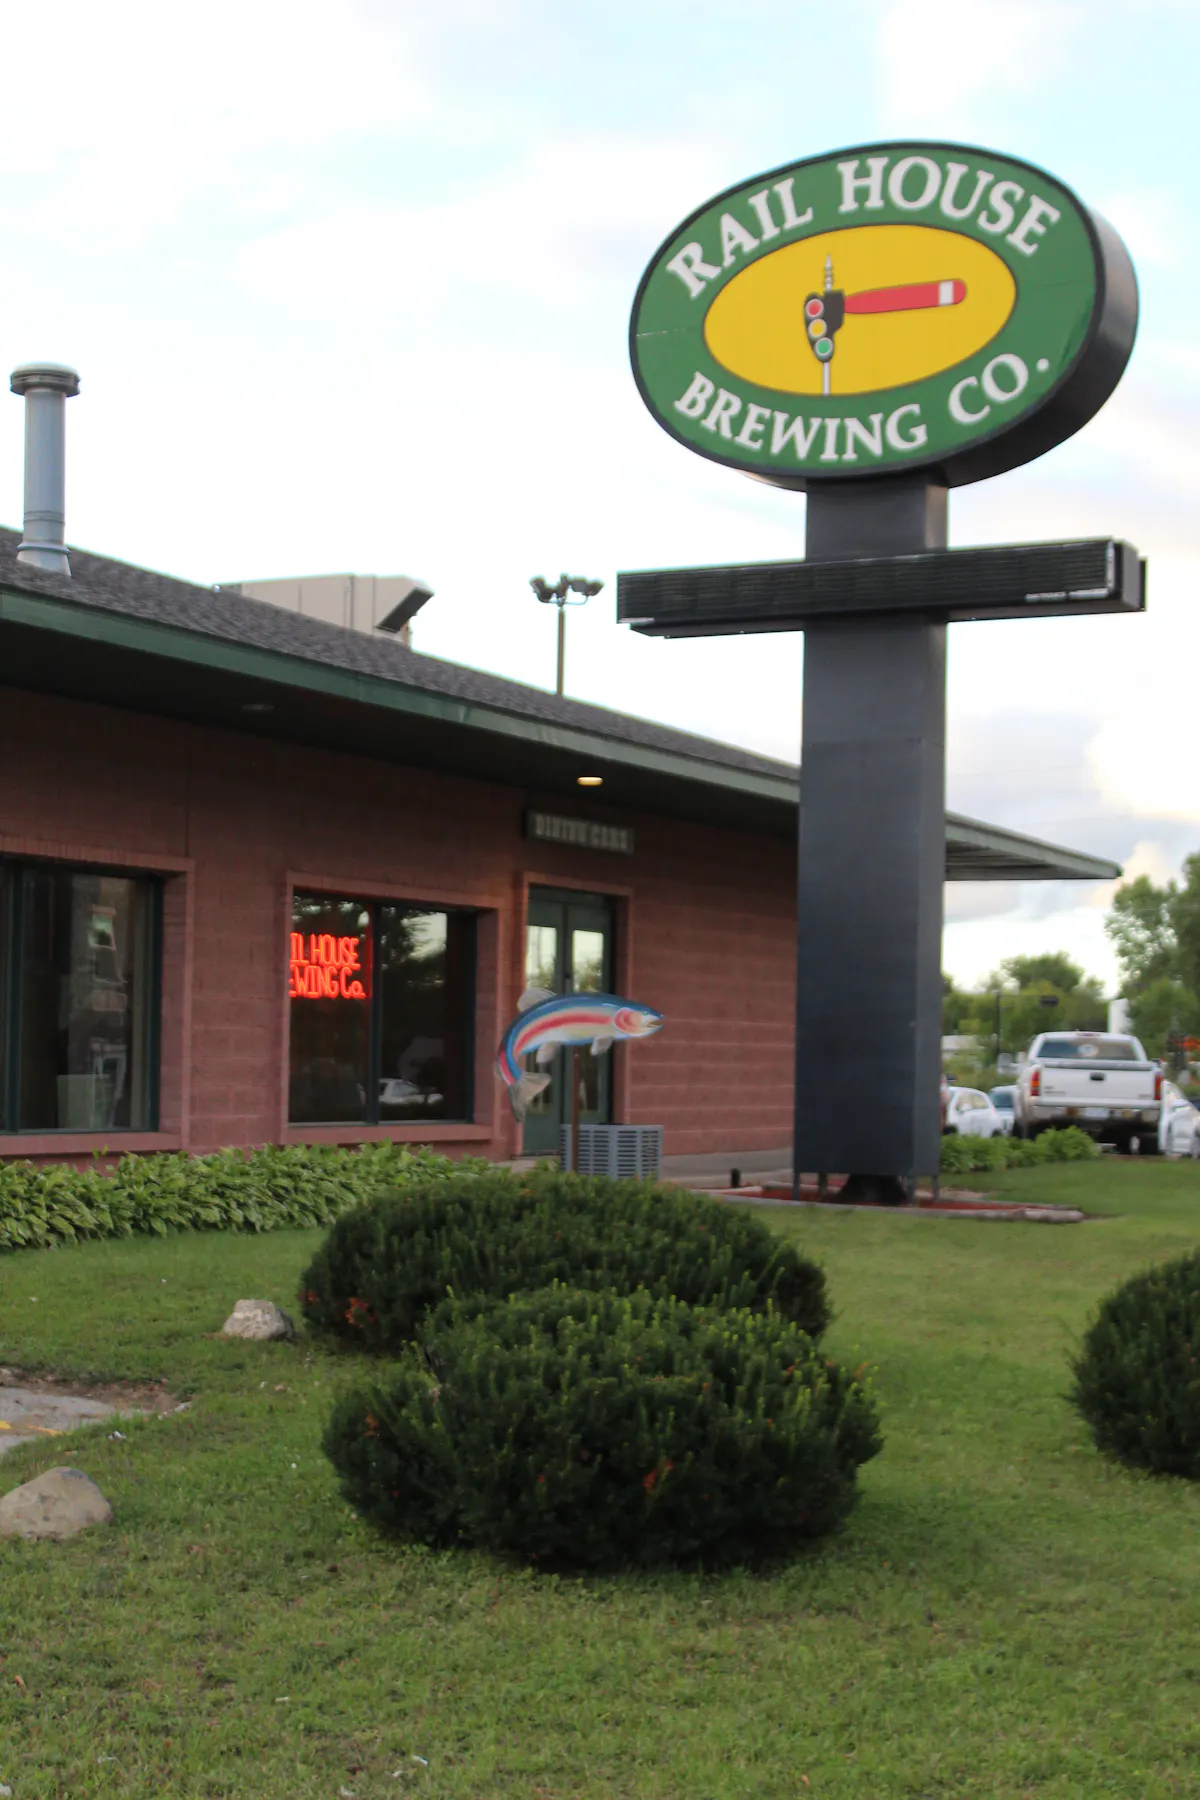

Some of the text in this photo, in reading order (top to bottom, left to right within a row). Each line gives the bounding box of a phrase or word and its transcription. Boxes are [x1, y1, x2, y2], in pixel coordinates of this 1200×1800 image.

[666, 156, 1061, 300] RAIL HOUSE
[674, 353, 1051, 462] BREWING CO.
[310, 933, 361, 971] HOUSE
